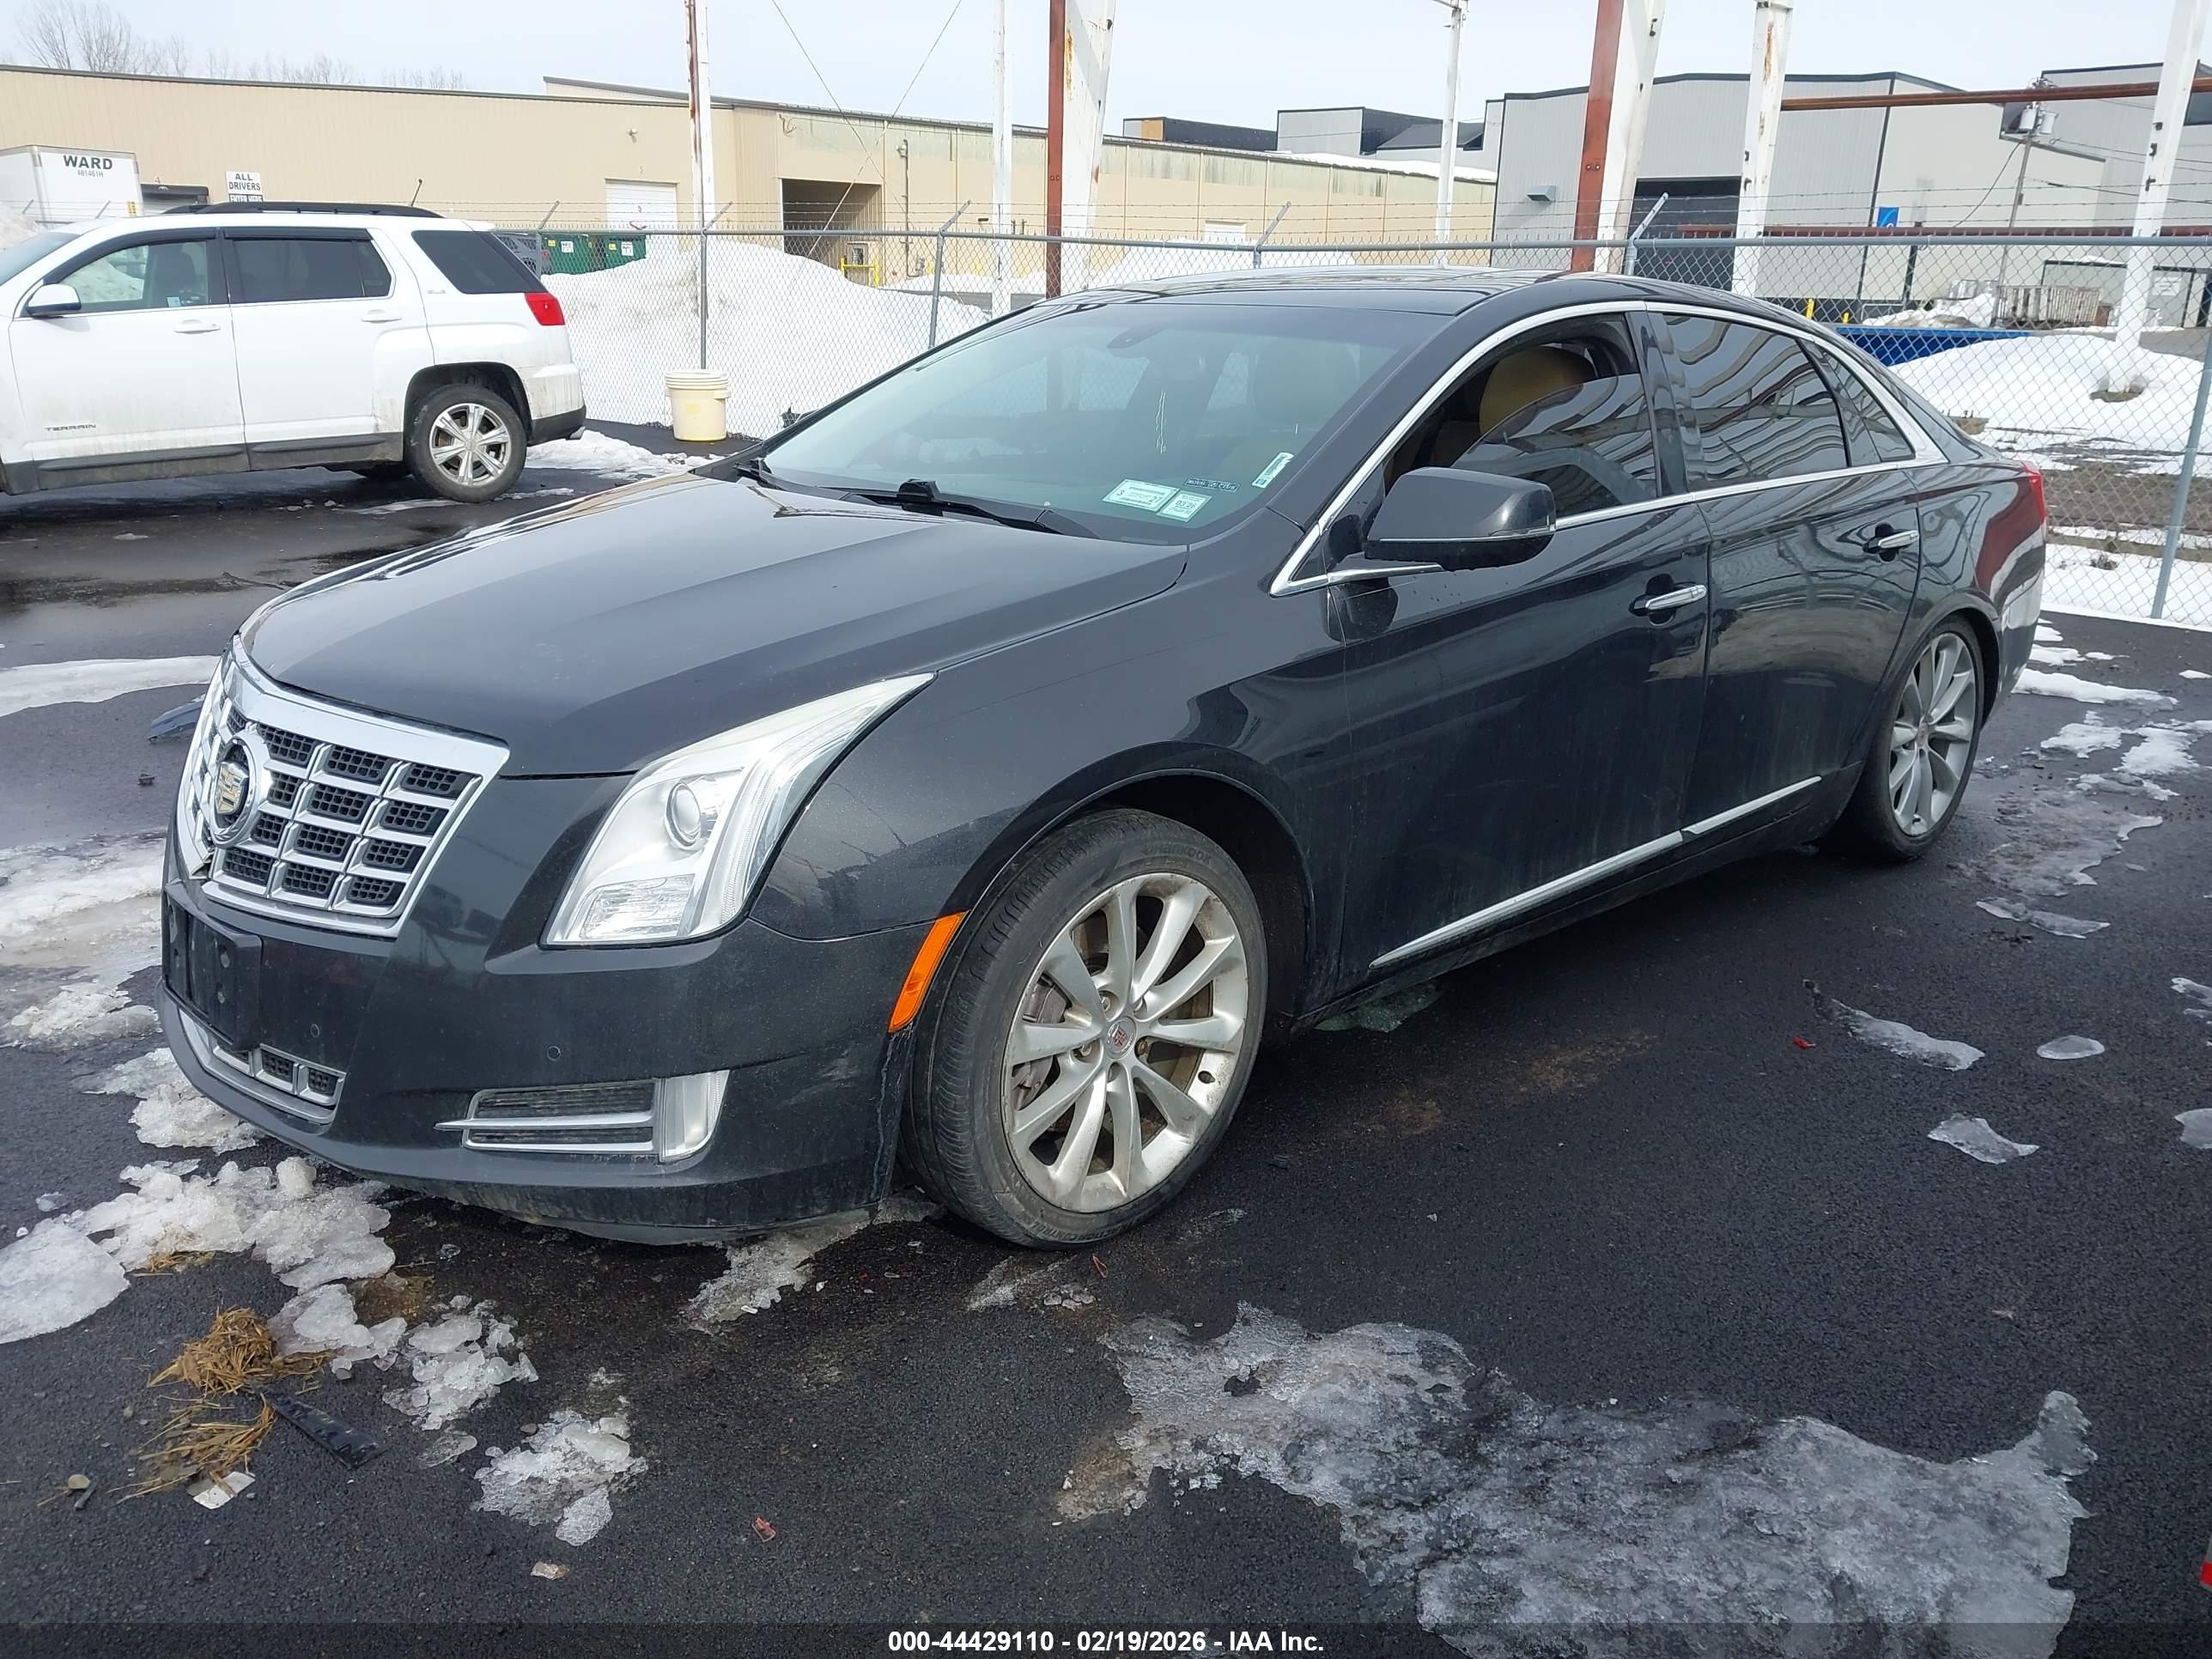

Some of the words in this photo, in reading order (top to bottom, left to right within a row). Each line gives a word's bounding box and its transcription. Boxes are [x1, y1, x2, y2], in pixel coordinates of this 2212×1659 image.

[63, 155, 112, 170] WARD
[234, 173, 253, 181] ALL
[228, 181, 261, 191] DRIVERS
